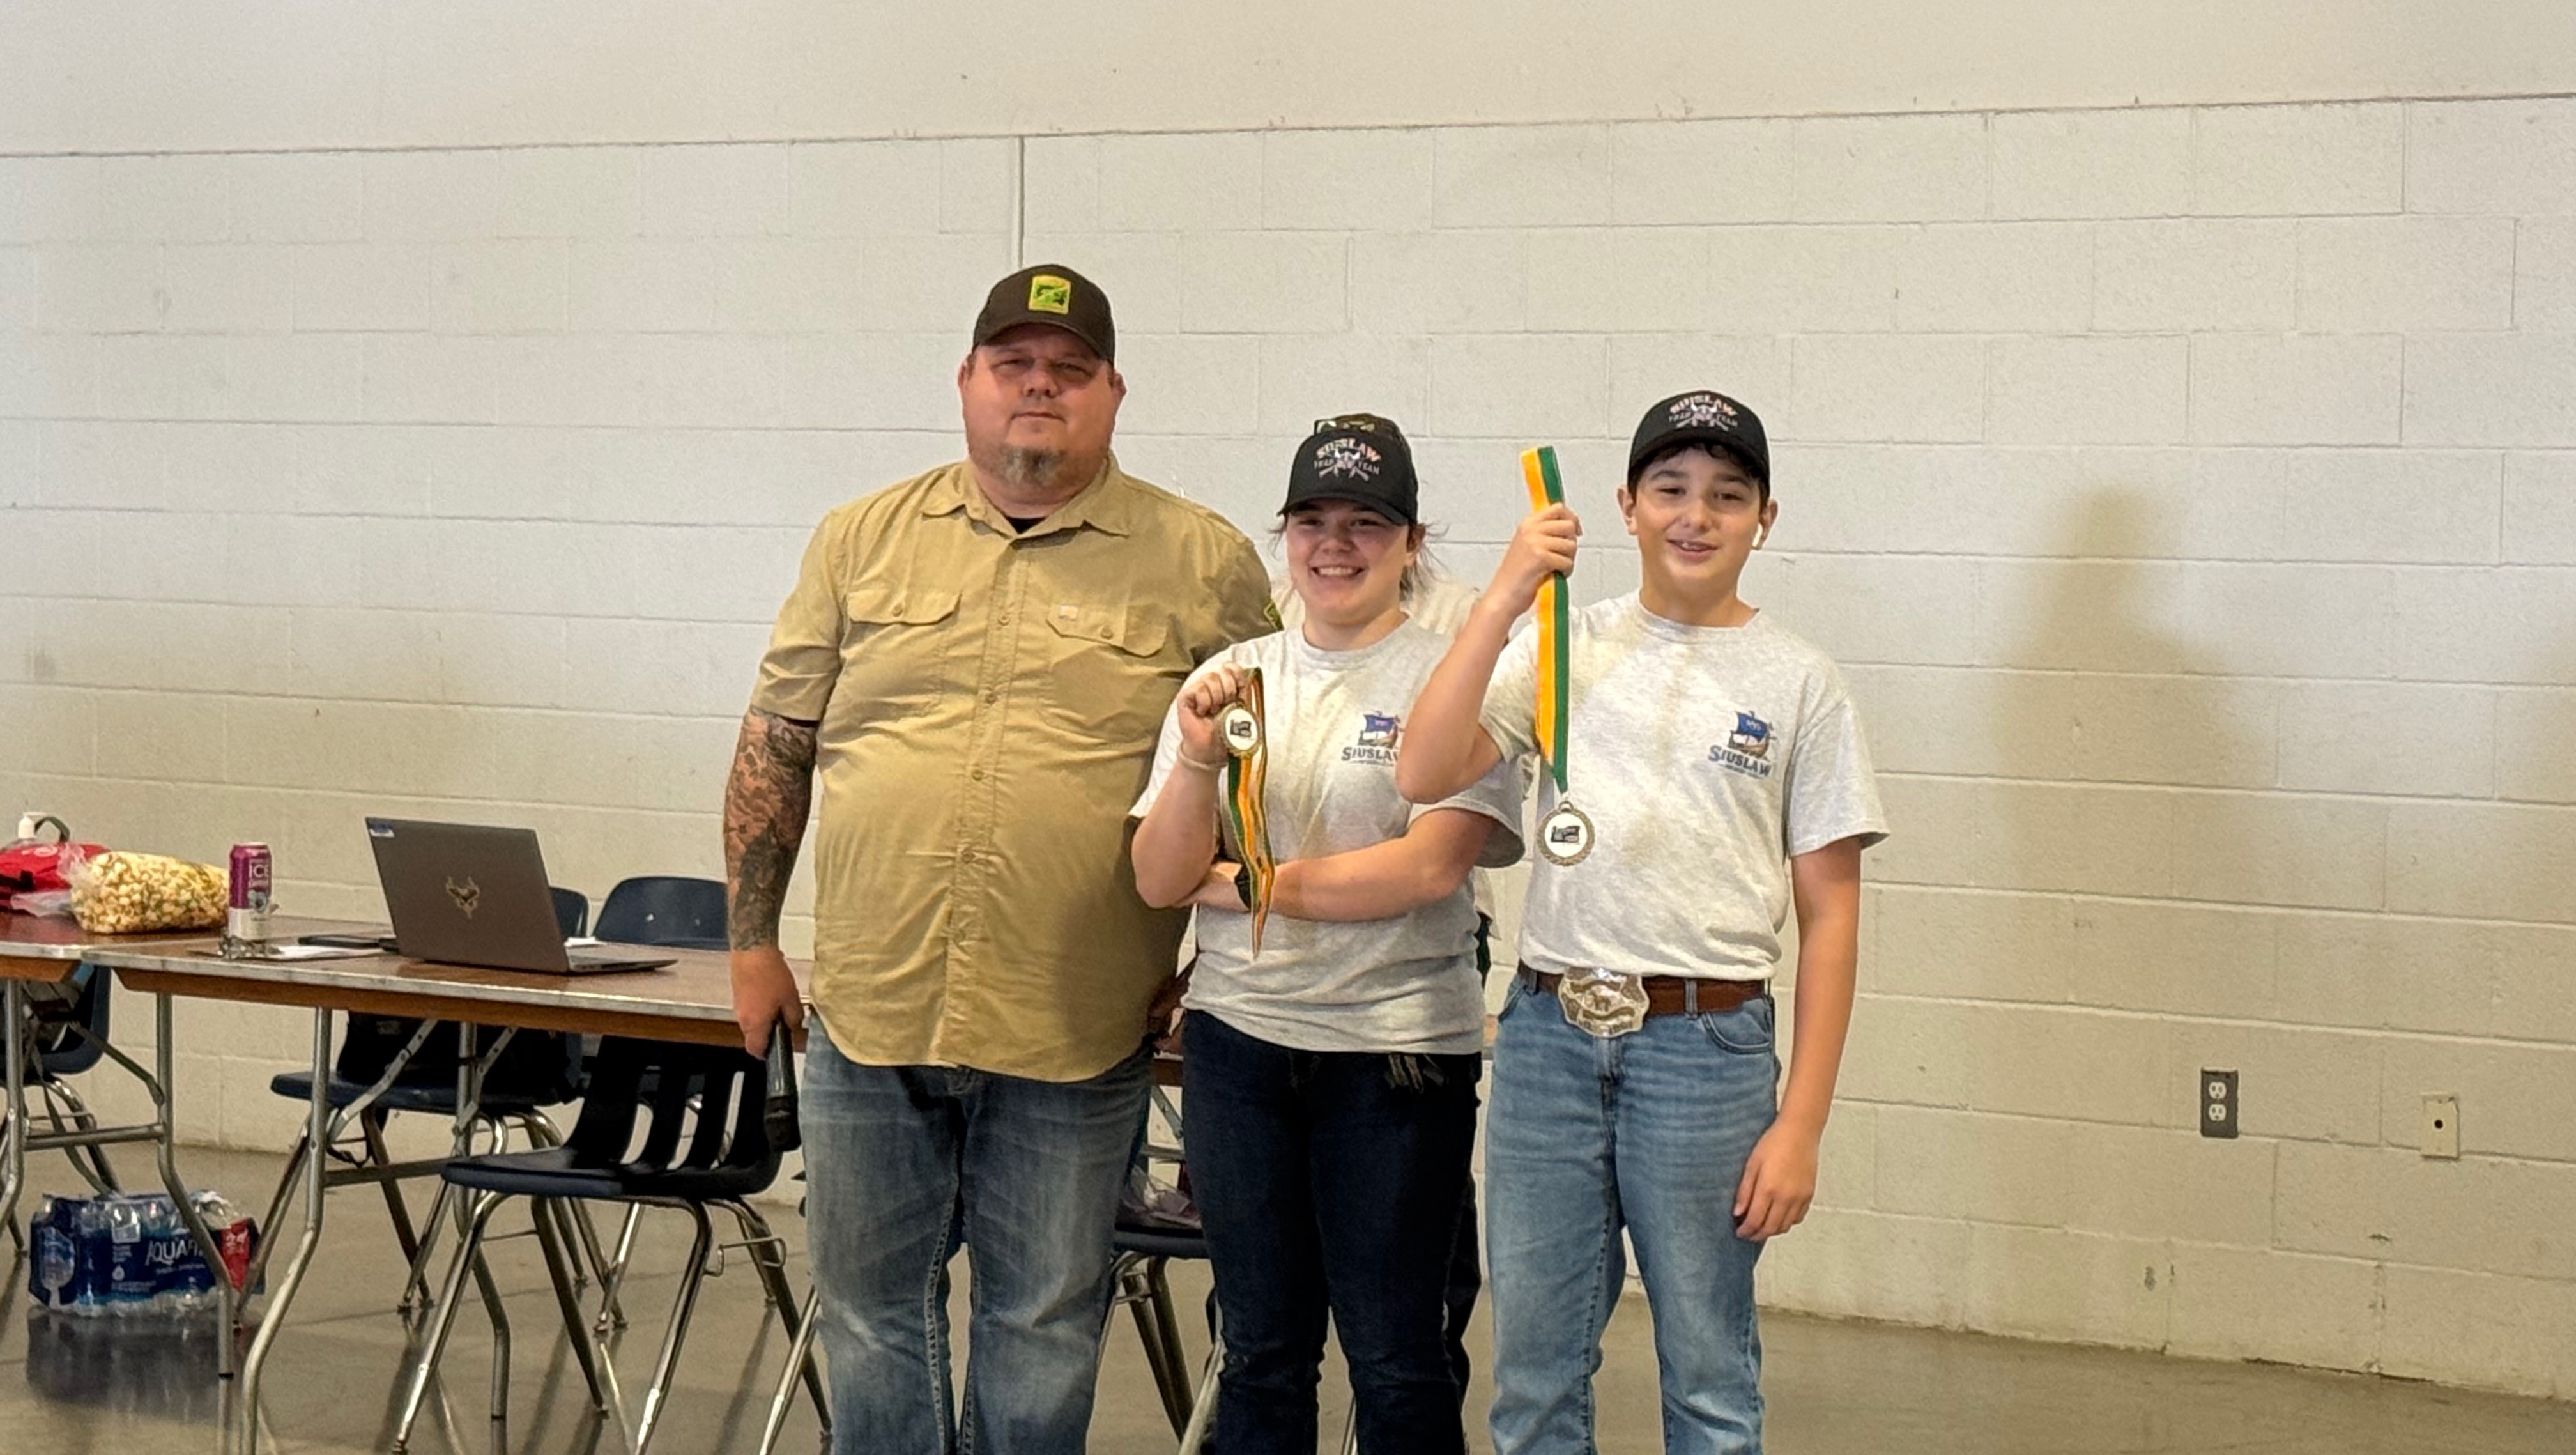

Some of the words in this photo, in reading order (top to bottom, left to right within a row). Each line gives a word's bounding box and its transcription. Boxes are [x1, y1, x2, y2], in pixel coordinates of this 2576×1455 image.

[1670, 394, 1738, 416] SIUSLAW
[1317, 438, 1381, 462] SIUSLAW
[1358, 461, 1380, 475] TEAM
[1708, 745, 1772, 776] SIUSLAW
[144, 1240, 204, 1266] AQUAFI
